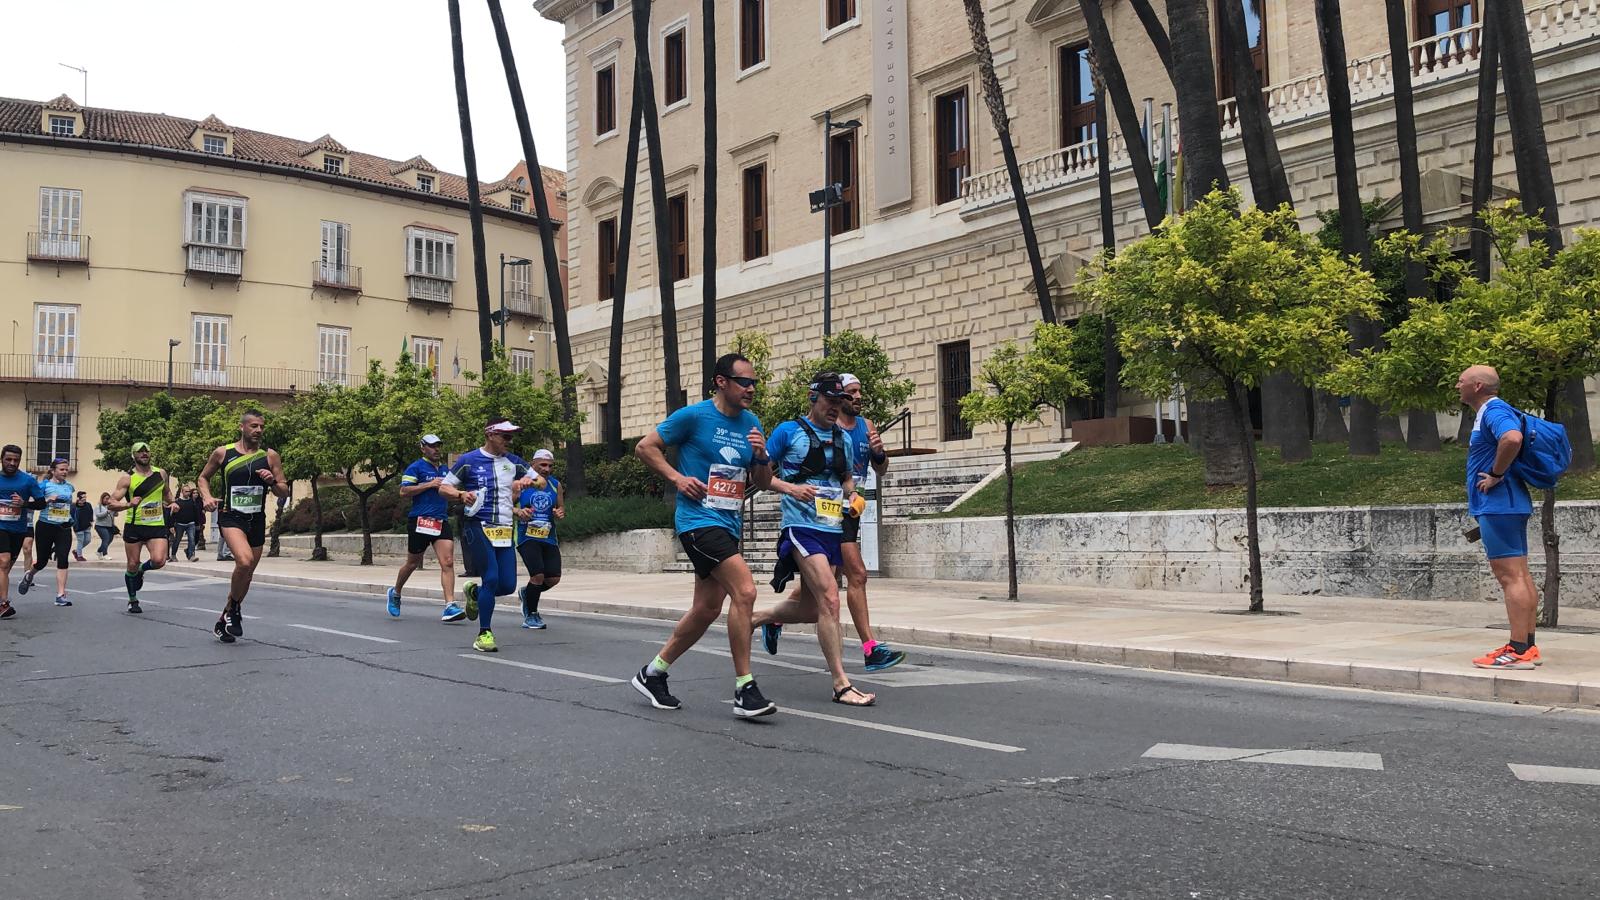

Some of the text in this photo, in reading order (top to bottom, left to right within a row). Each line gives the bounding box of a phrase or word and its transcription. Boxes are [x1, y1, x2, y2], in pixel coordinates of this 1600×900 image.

[886, 0, 896, 155] MUSEO DE MALA
[712, 481, 737, 494] 4272
[234, 496, 253, 504] 1720
[821, 501, 841, 512] 6777
